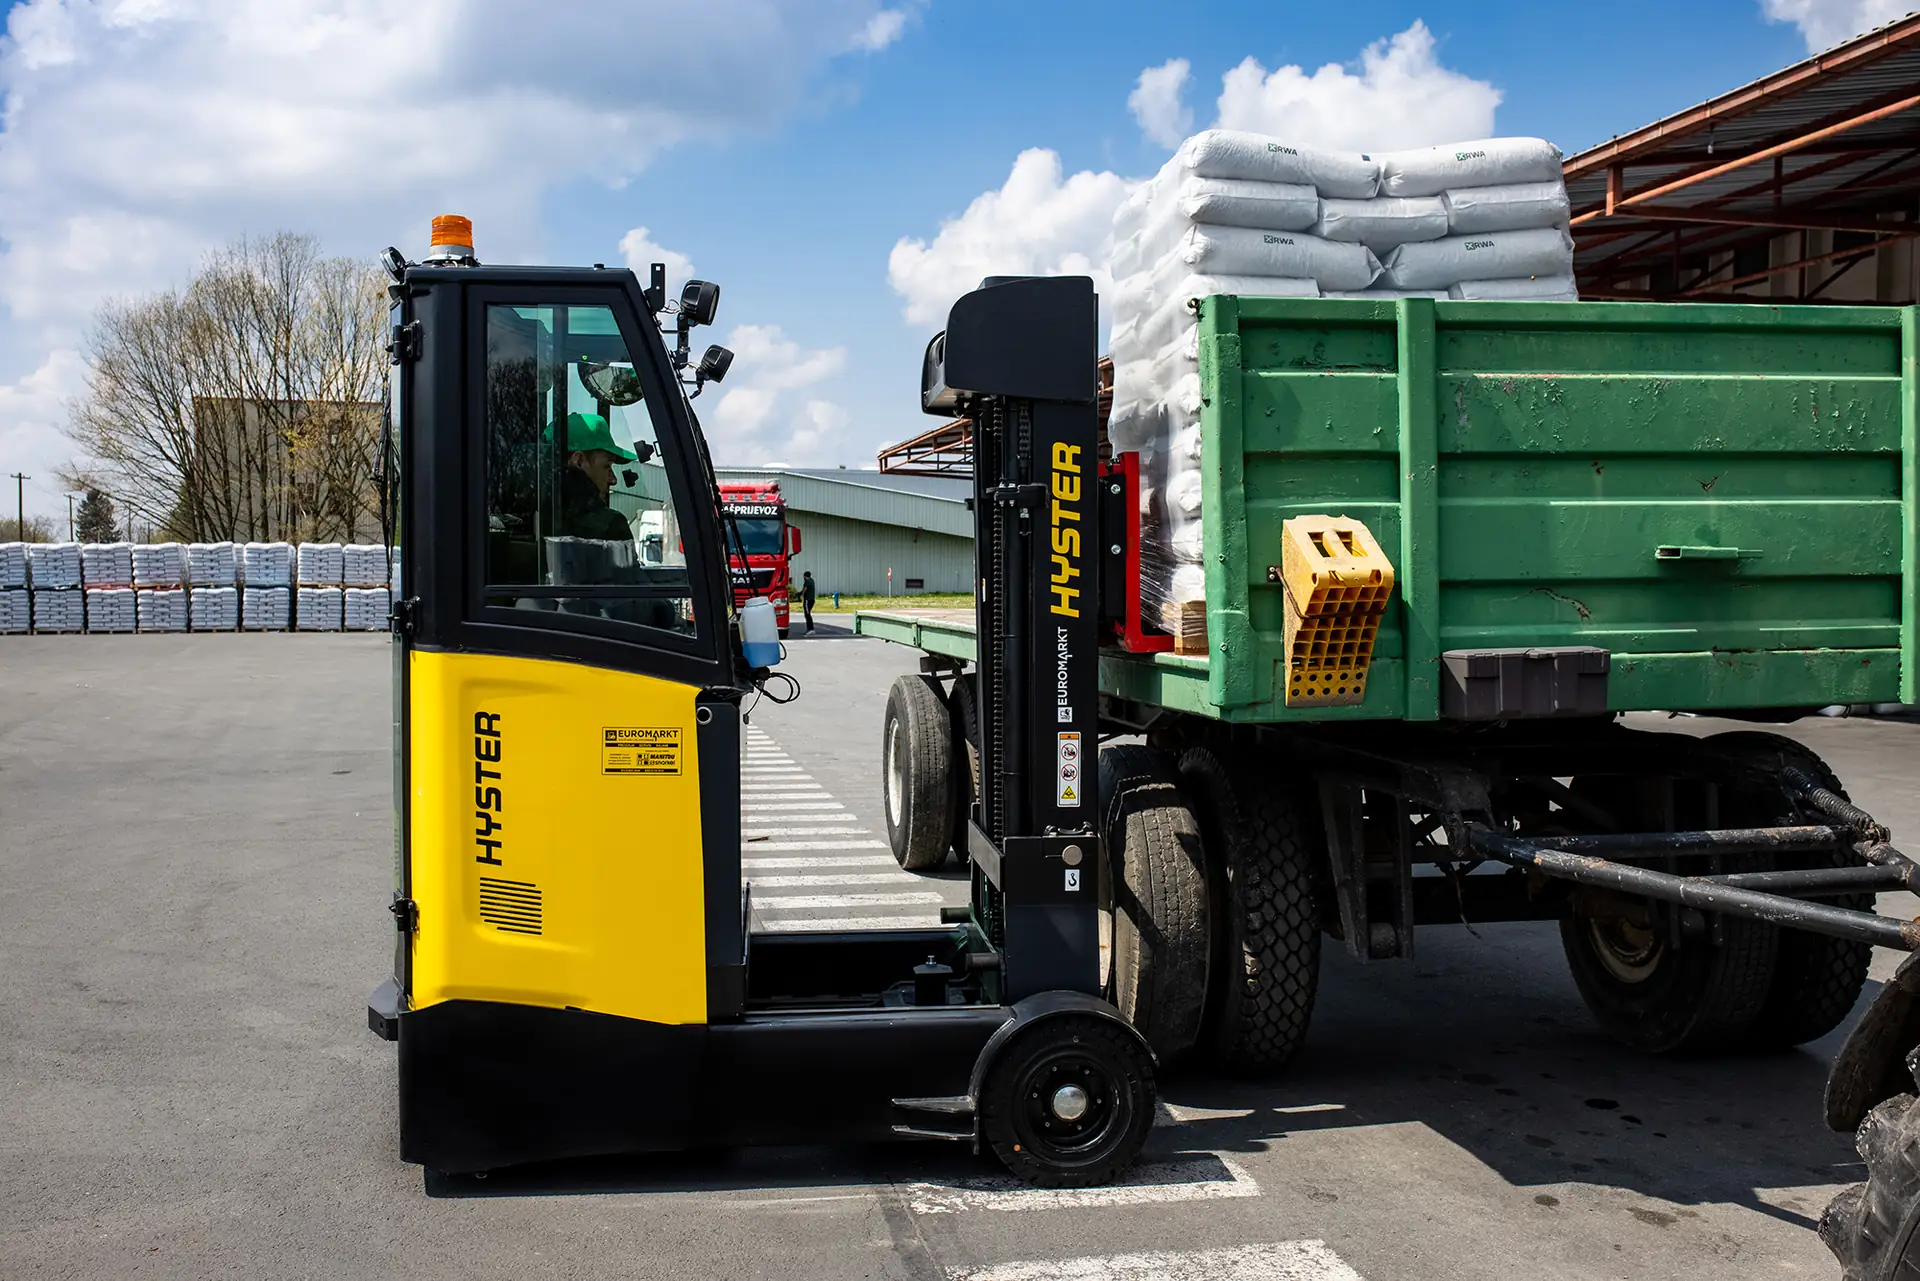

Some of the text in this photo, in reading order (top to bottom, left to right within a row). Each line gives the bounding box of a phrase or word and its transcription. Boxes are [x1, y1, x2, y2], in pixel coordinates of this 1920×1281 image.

[1277, 146, 1298, 156] RWA
[1465, 150, 1486, 160] RWA
[1273, 237, 1295, 246] RWA
[1474, 240, 1495, 249] RWA
[1050, 441, 1081, 618] HYSTER
[1057, 626, 1074, 706] EUROMARKT
[618, 730, 678, 741] EUROMARKT
[474, 711, 502, 866] HYSTER
